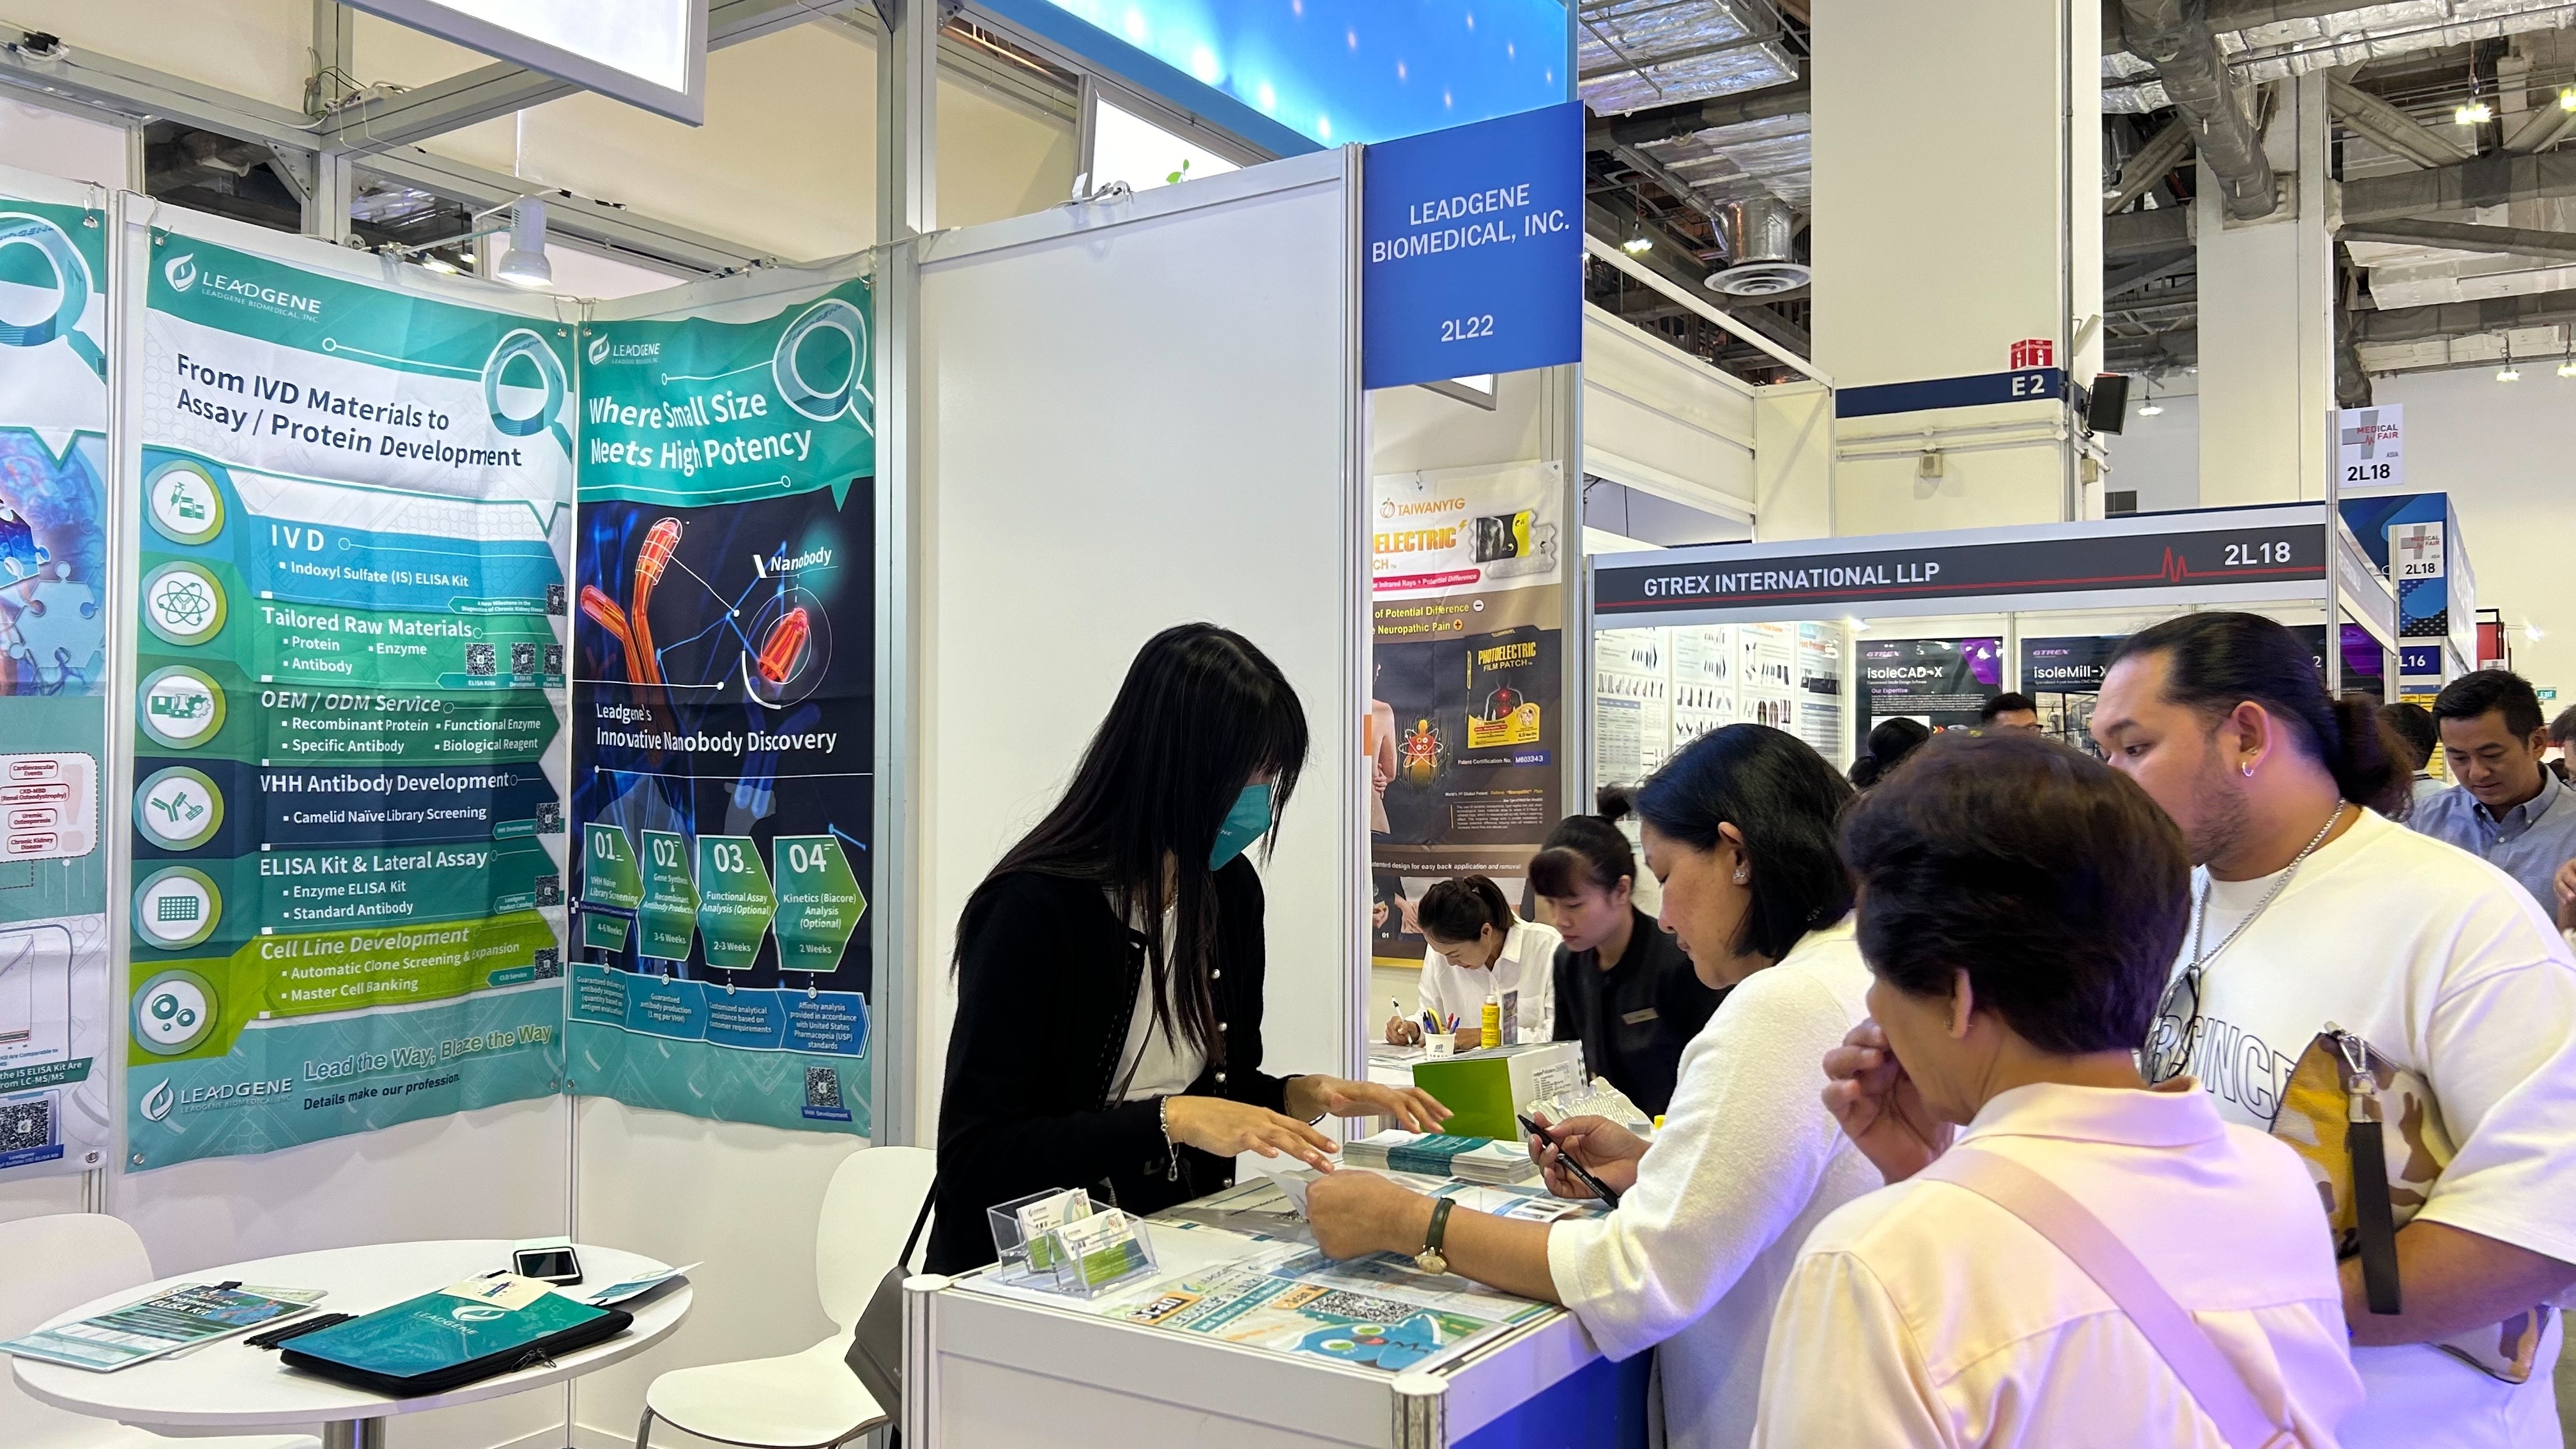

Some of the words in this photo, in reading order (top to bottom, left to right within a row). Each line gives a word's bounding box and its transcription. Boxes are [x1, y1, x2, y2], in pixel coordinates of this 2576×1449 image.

[1410, 183, 1529, 226] LEADGENE
[1372, 220, 1515, 263] BIOMEDICAL,
[1524, 209, 1569, 236] INC.
[202, 289, 246, 305] LEADGENE
[203, 272, 321, 314] LEADGENE
[1441, 314, 1493, 342] 2L22
[613, 343, 661, 356] LEADGENE
[178, 353, 245, 394] From
[254, 376, 299, 404] IVD
[307, 390, 422, 430] Materials
[428, 410, 448, 430] to
[589, 396, 661, 429] Where
[665, 396, 710, 429] Small
[712, 391, 767, 424] Size
[178, 389, 247, 432] Assay
[252, 409, 264, 436] /
[272, 414, 372, 453] Protein
[379, 436, 522, 468] Development
[2357, 424, 2398, 434] MEDICAL
[2378, 431, 2398, 440] FAIR
[591, 438, 653, 467] Meets
[660, 443, 703, 477] High
[705, 430, 811, 468] Potency
[2347, 464, 2390, 481] 2L18
[1398, 498, 1465, 516] TAIWANYTG
[770, 547, 832, 572] Nanobody
[2225, 542, 2290, 565] 2L18
[291, 561, 341, 579] Indoxyl
[343, 567, 387, 583] Sulfate
[392, 571, 413, 586] (IS)
[415, 572, 449, 586] ELISA
[452, 574, 469, 588] Kit
[2405, 563, 2435, 574] 2L18
[1644, 575, 1710, 597] GTREX
[1715, 565, 1890, 593] INTERNATIONAL
[1896, 562, 1940, 583] LLP
[1375, 610, 1383, 618] of
[1386, 606, 1423, 618] Potential
[1426, 604, 1469, 616] Difference
[261, 606, 339, 631] Tailored
[345, 616, 383, 634] Raw
[388, 618, 472, 638] Materials
[1378, 622, 1429, 636] Neuropathic
[1432, 622, 1450, 631] Pain
[292, 636, 340, 652] Protein
[376, 643, 427, 656] Enzyme
[1478, 642, 1536, 664] PHOTOELECTRIC
[292, 657, 353, 675] Antibody
[1483, 662, 1498, 671] FILM
[1500, 659, 1527, 668] PATCH
[1867, 666, 1943, 679] isoleCAD-X
[262, 690, 307, 709] OEM
[311, 693, 318, 712] /
[325, 693, 369, 710] ODM
[375, 695, 440, 713] Service
[597, 703, 652, 724] Leadgene's
[292, 717, 383, 732] Recombinant
[386, 719, 429, 732] Protein
[444, 719, 506, 732] Functional
[508, 719, 540, 732] Enzyme
[292, 739, 345, 753] Specific
[348, 739, 404, 754] Antibody
[443, 740, 502, 753] Biological
[503, 738, 538, 752] Reagent
[597, 727, 661, 751] Innovative
[664, 731, 742, 756] Nanobody
[747, 732, 837, 753] Discovery
[261, 774, 302, 792] VHH
[307, 774, 394, 795] Antibody
[397, 772, 509, 793] Development
[294, 811, 345, 824] Camelid
[348, 809, 385, 823] Naïve
[387, 808, 424, 823] Library
[427, 806, 486, 822] Screening
[595, 831, 615, 860] 01
[654, 838, 677, 867] 02
[261, 857, 316, 877] ELISA
[321, 855, 348, 874] Kit
[353, 855, 367, 873] &
[373, 851, 432, 871] Lateral
[436, 850, 487, 870] Assay
[714, 843, 744, 873] 03
[789, 843, 827, 873] 04
[294, 884, 345, 899] Enzyme
[349, 881, 387, 896] ELISA
[390, 880, 406, 893] Kit
[590, 887, 608, 899] Library
[609, 893, 638, 904] Screening
[707, 891, 747, 901] Functional
[747, 893, 768, 904] Assay
[783, 894, 818, 903] Kinetics
[821, 894, 856, 903] (Biacore)
[294, 905, 353, 920] Standard
[356, 901, 413, 916] Antibody
[643, 901, 668, 911] Antibody
[702, 903, 737, 915] Analysis
[734, 905, 771, 916] (Optional)
[805, 906, 838, 917] Analysis
[607, 925, 622, 936] Weeks
[801, 919, 841, 930] (Optional)
[261, 940, 297, 960] Cell
[303, 937, 344, 957] Line
[350, 927, 470, 954] Development
[654, 933, 664, 941] 3-6
[665, 934, 686, 944] Weeks
[714, 942, 726, 950] 2-3
[728, 942, 751, 952] Weeks
[806, 944, 832, 953] Weeks
[291, 962, 360, 980] Automatic
[364, 958, 400, 973] Clone
[402, 952, 461, 971] Screening
[463, 951, 470, 962] &
[471, 941, 519, 960] Expansion
[291, 986, 337, 1002] Master
[341, 981, 364, 998] Cell
[367, 977, 418, 995] Banking
[790, 1011, 814, 1020] provided
[822, 1013, 857, 1021] accordance
[799, 1002, 819, 1011] Affinity
[821, 1004, 845, 1012] analysis
[808, 1041, 838, 1050] standards
[836, 1034, 852, 1042] (USP)
[303, 1057, 353, 1081] Lead
[357, 1054, 387, 1074] the
[392, 1047, 435, 1071] Way,
[440, 1036, 482, 1060] Blaze
[488, 1029, 513, 1049] the
[517, 1025, 551, 1044] Way
[27, 1066, 52, 1075] ELISA
[67, 1062, 82, 1070] Are
[20, 1073, 65, 1086] LC-MS/MS
[181, 1078, 292, 1104] LEADGENE
[303, 1092, 346, 1110] Details
[348, 1086, 378, 1101] make
[382, 1084, 402, 1098] our
[406, 1073, 460, 1095] profession.
[181, 1103, 222, 1113] LEADGENE
